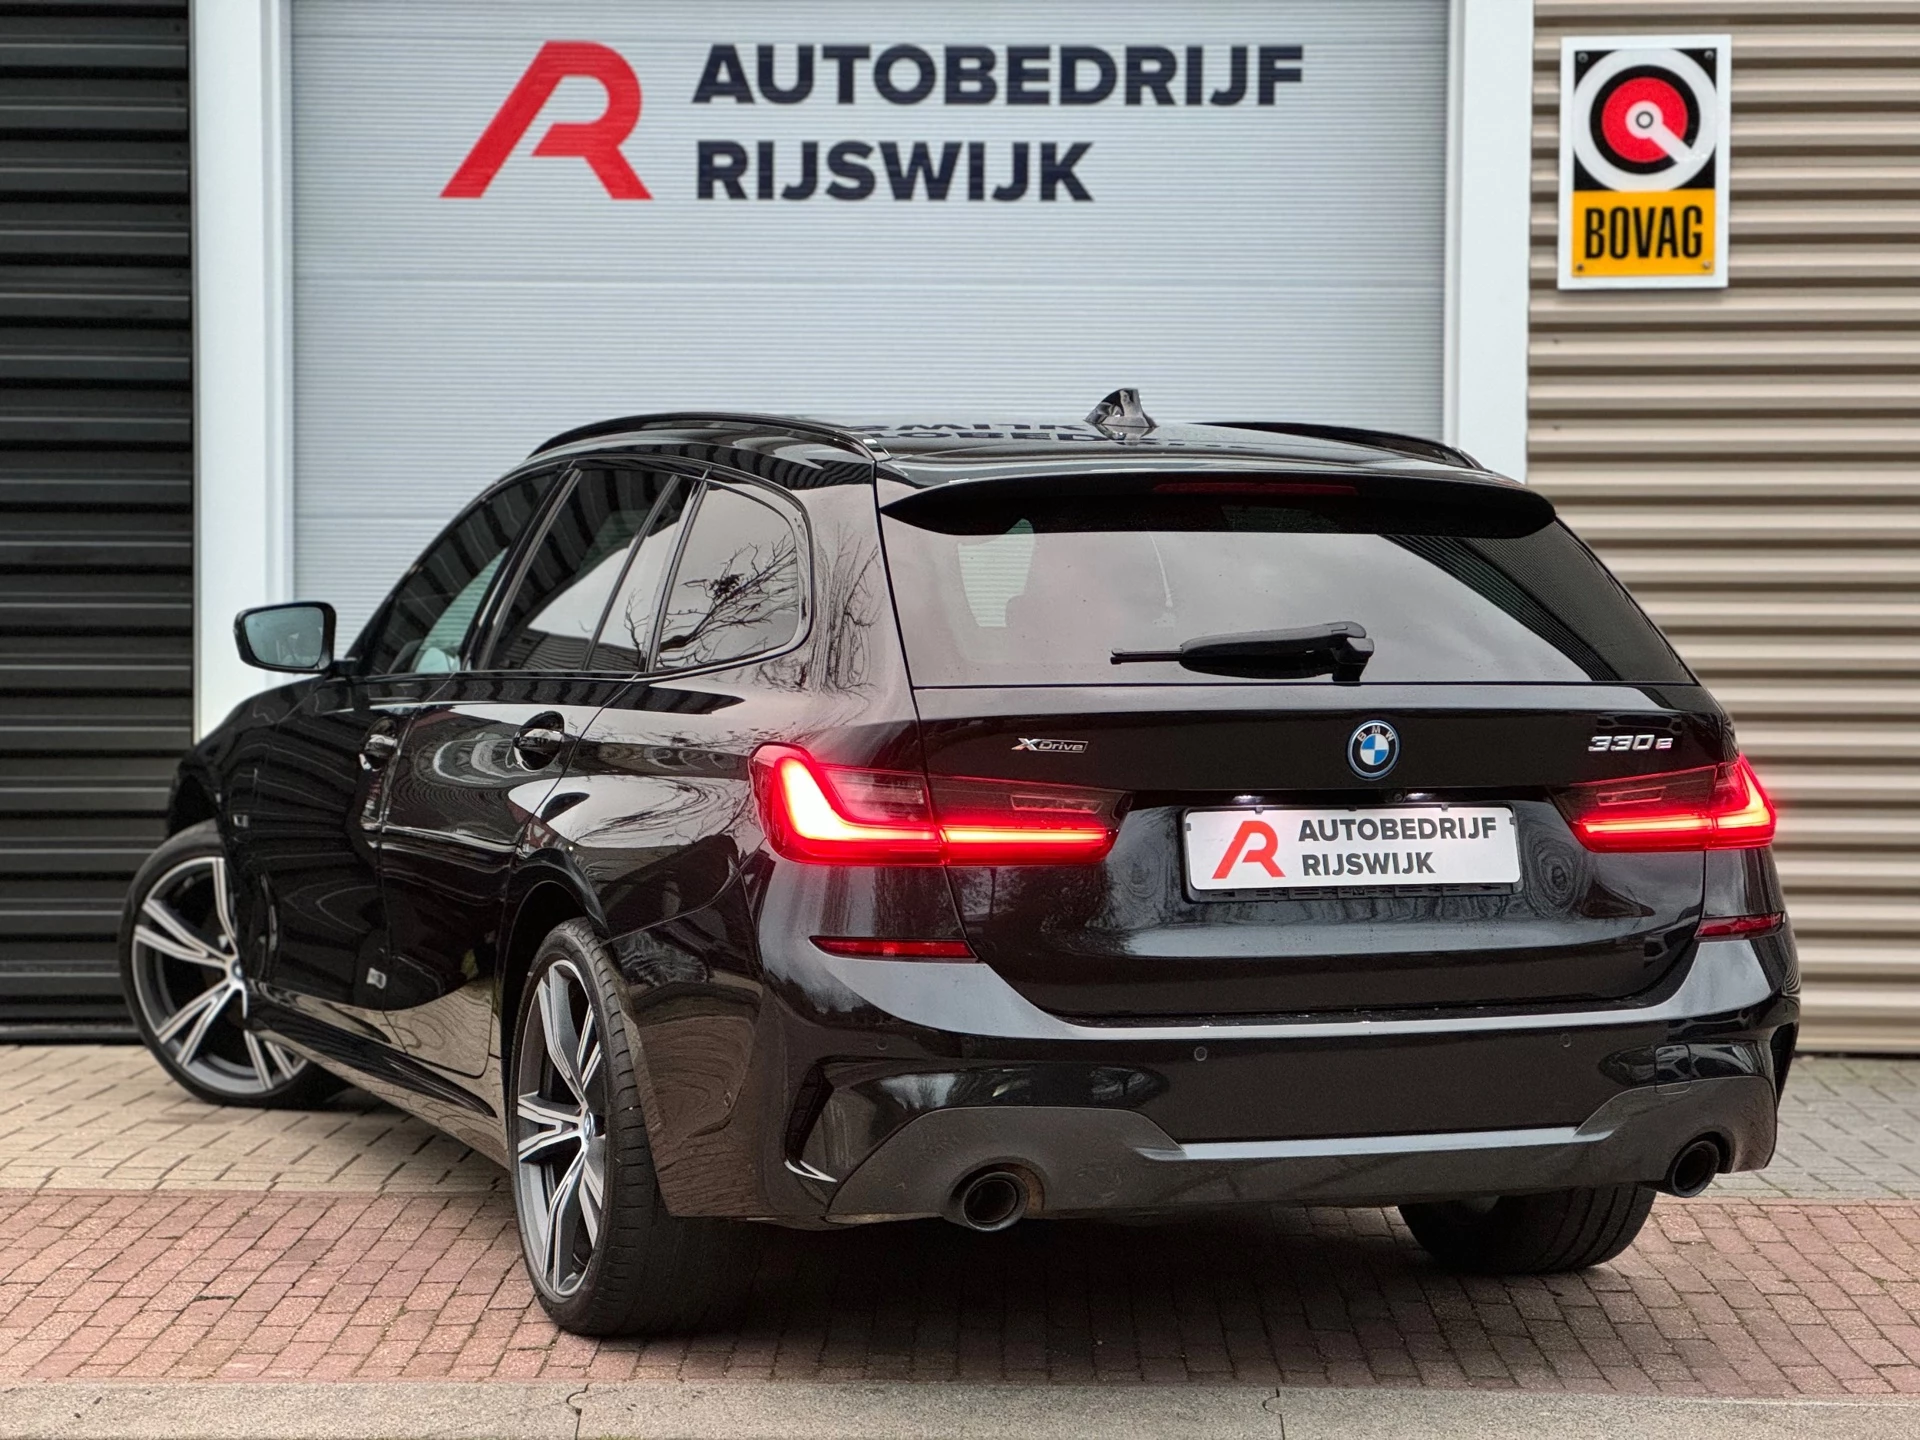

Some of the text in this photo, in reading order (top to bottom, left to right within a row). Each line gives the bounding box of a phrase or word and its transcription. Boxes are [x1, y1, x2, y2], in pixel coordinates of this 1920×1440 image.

[693, 45, 1303, 107] AUTOBEDRIJF
[697, 140, 1093, 201] RIJSWIJK
[1585, 205, 1703, 260] BOVAG
[1588, 734, 1674, 752] 330e
[1298, 817, 1497, 842] AUTOBEDRIJF
[1302, 852, 1436, 876] RIJSWIJK
